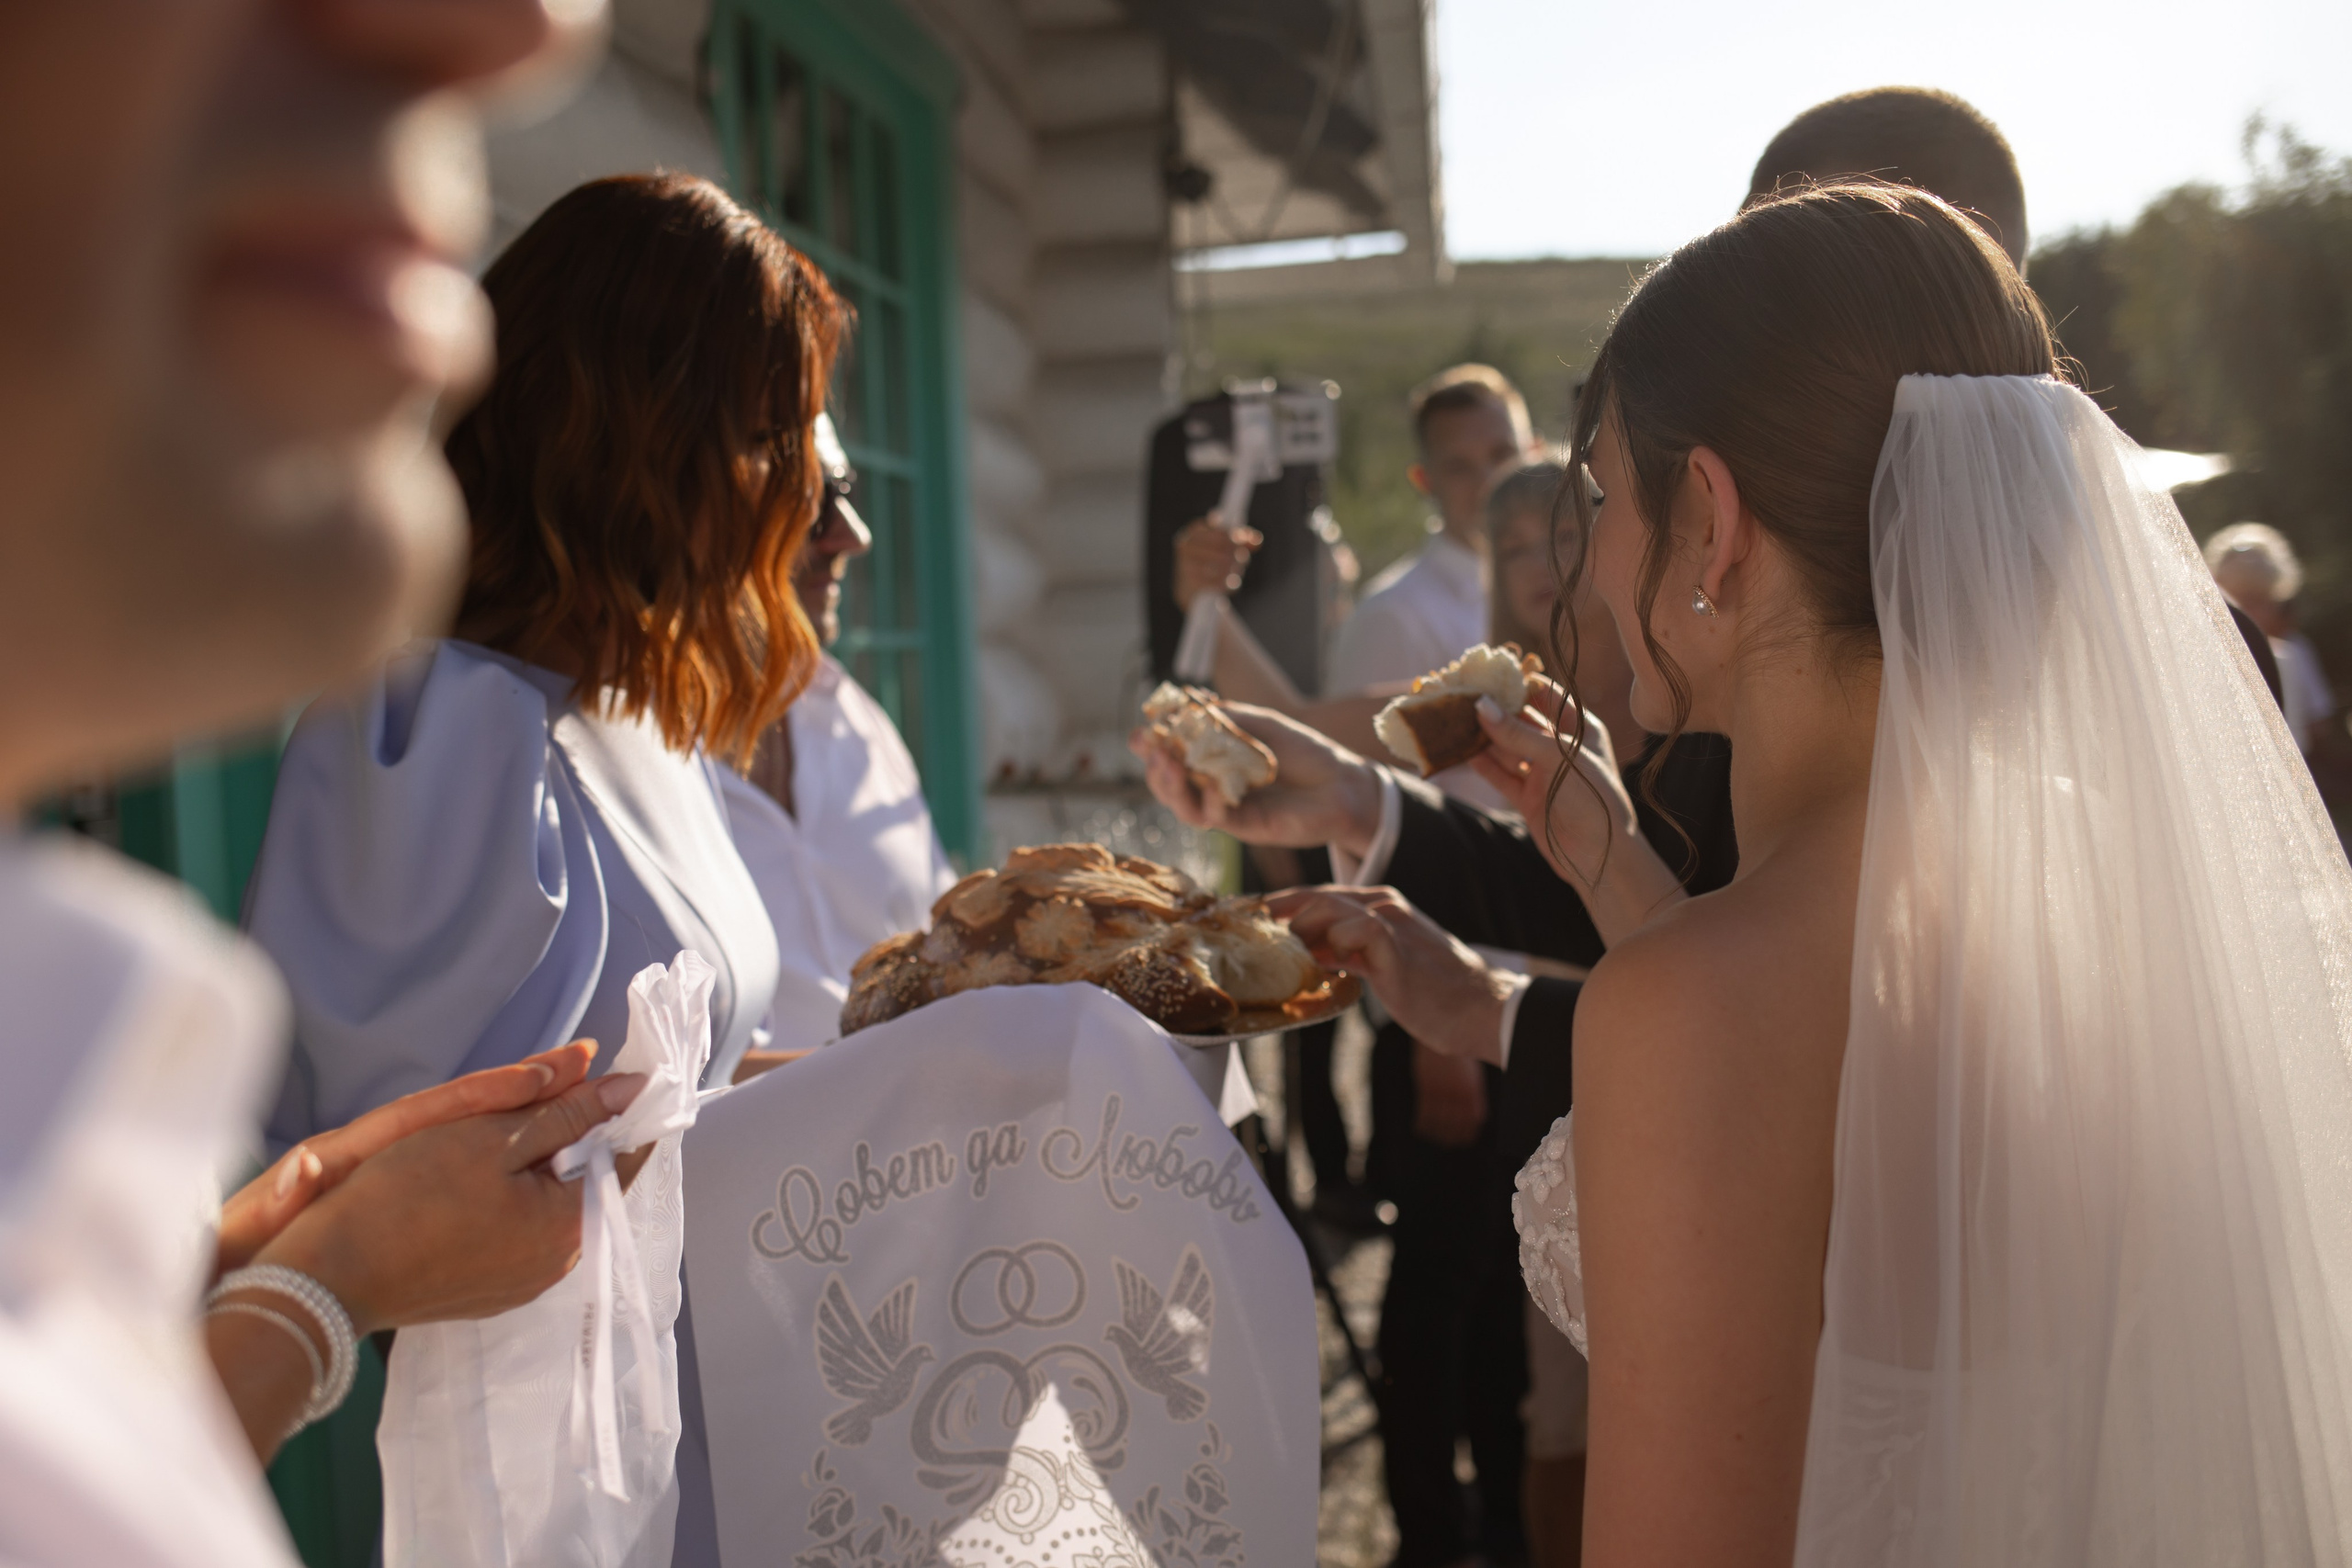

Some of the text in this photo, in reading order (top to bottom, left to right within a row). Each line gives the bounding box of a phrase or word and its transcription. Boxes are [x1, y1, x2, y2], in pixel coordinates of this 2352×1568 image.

[752, 1094, 1260, 1263] Совет да Любовь
